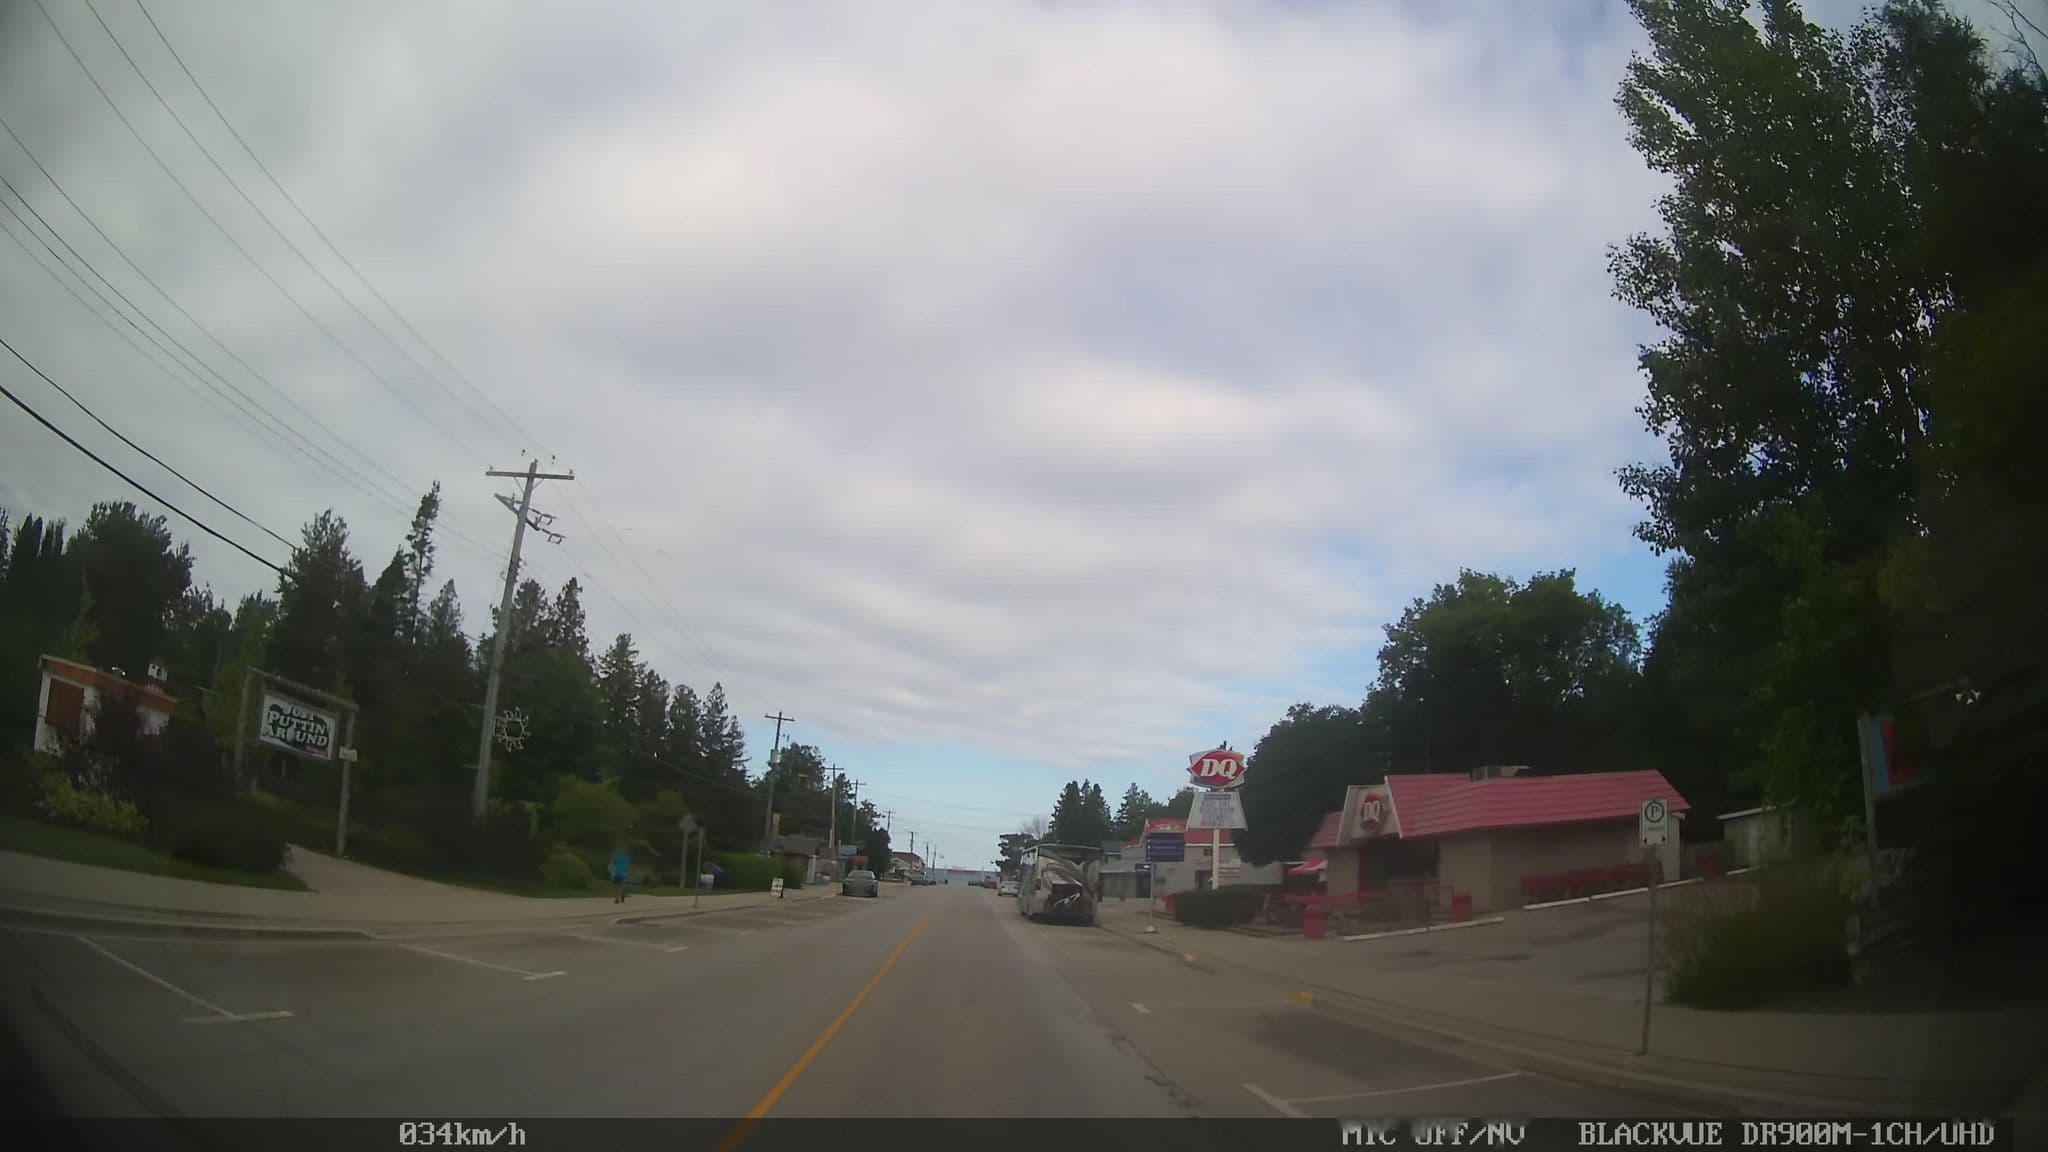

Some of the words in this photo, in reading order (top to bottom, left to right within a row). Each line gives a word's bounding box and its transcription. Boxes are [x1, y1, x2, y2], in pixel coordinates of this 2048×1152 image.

[1200, 758, 1237, 779] DQ
[1363, 800, 1381, 822] DQ
[1651, 805, 1660, 819] P
